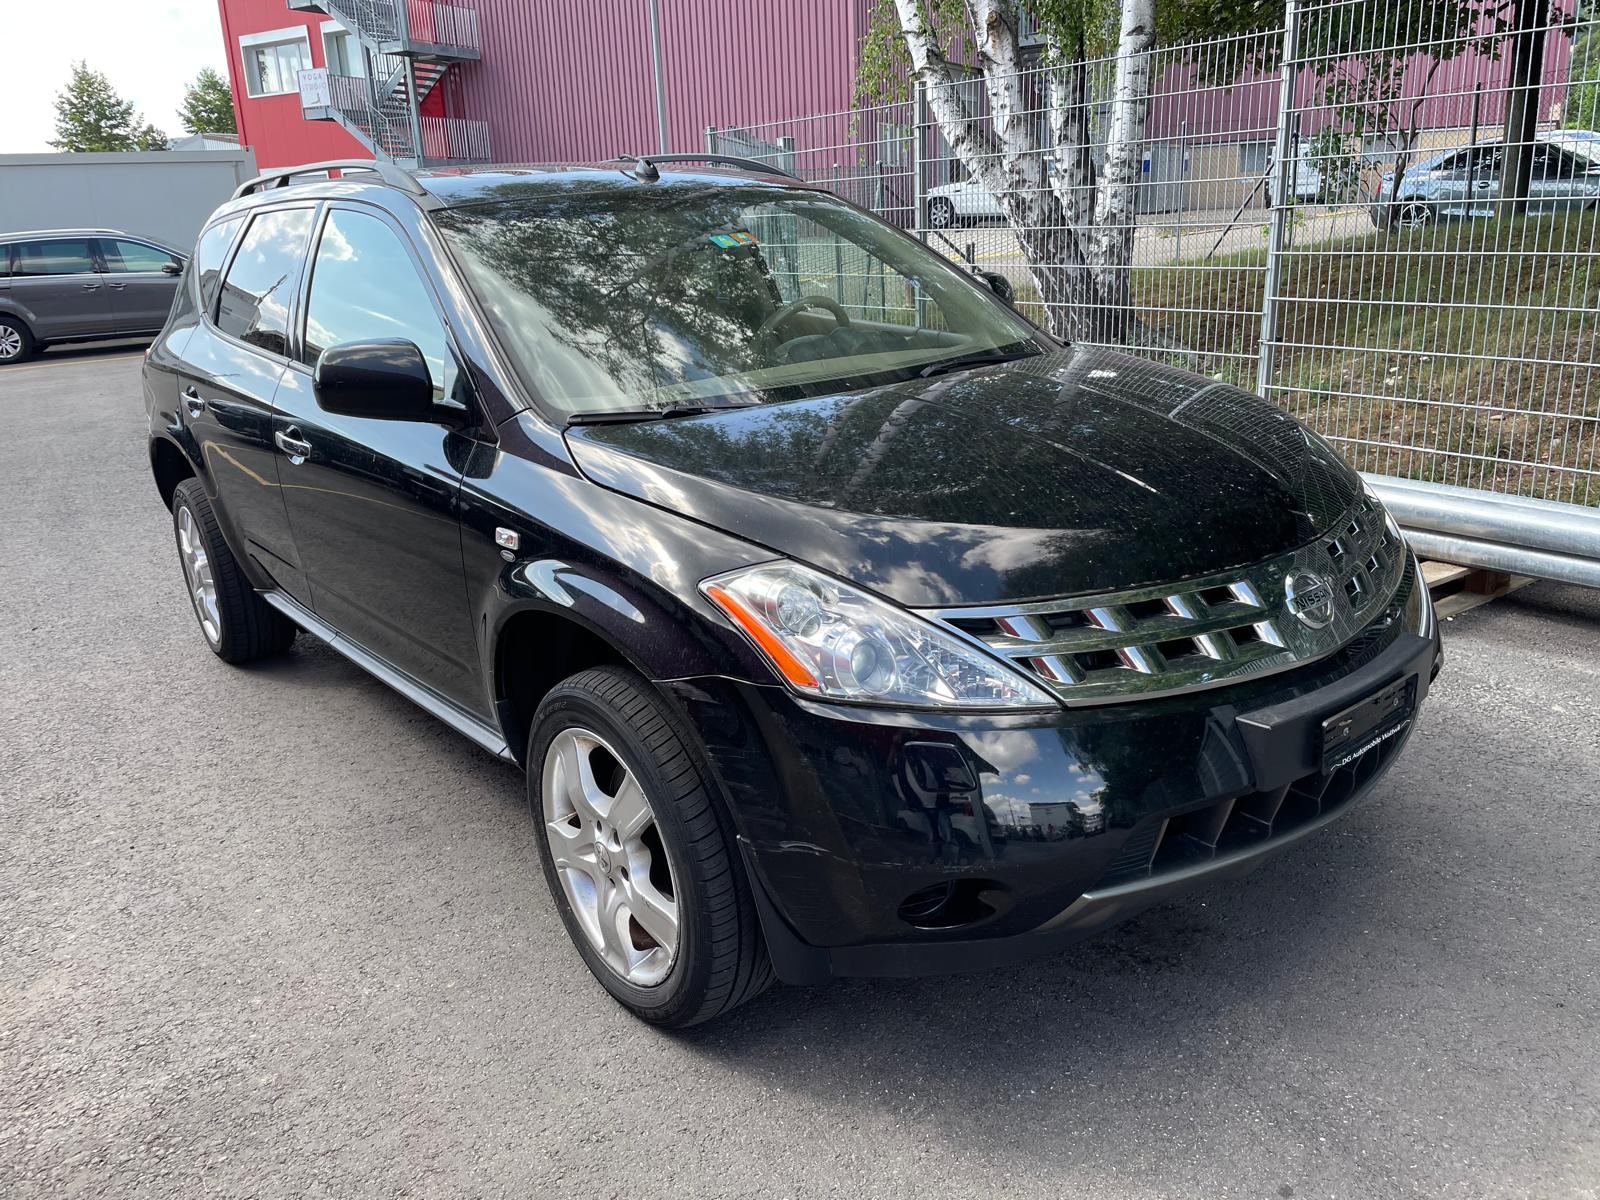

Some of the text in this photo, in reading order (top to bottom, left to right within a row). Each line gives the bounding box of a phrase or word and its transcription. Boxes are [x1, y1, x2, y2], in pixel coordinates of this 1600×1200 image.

[302, 73, 322, 81] YOGA
[1341, 755, 1352, 765] DG
[1352, 737, 1382, 760] Automobile
